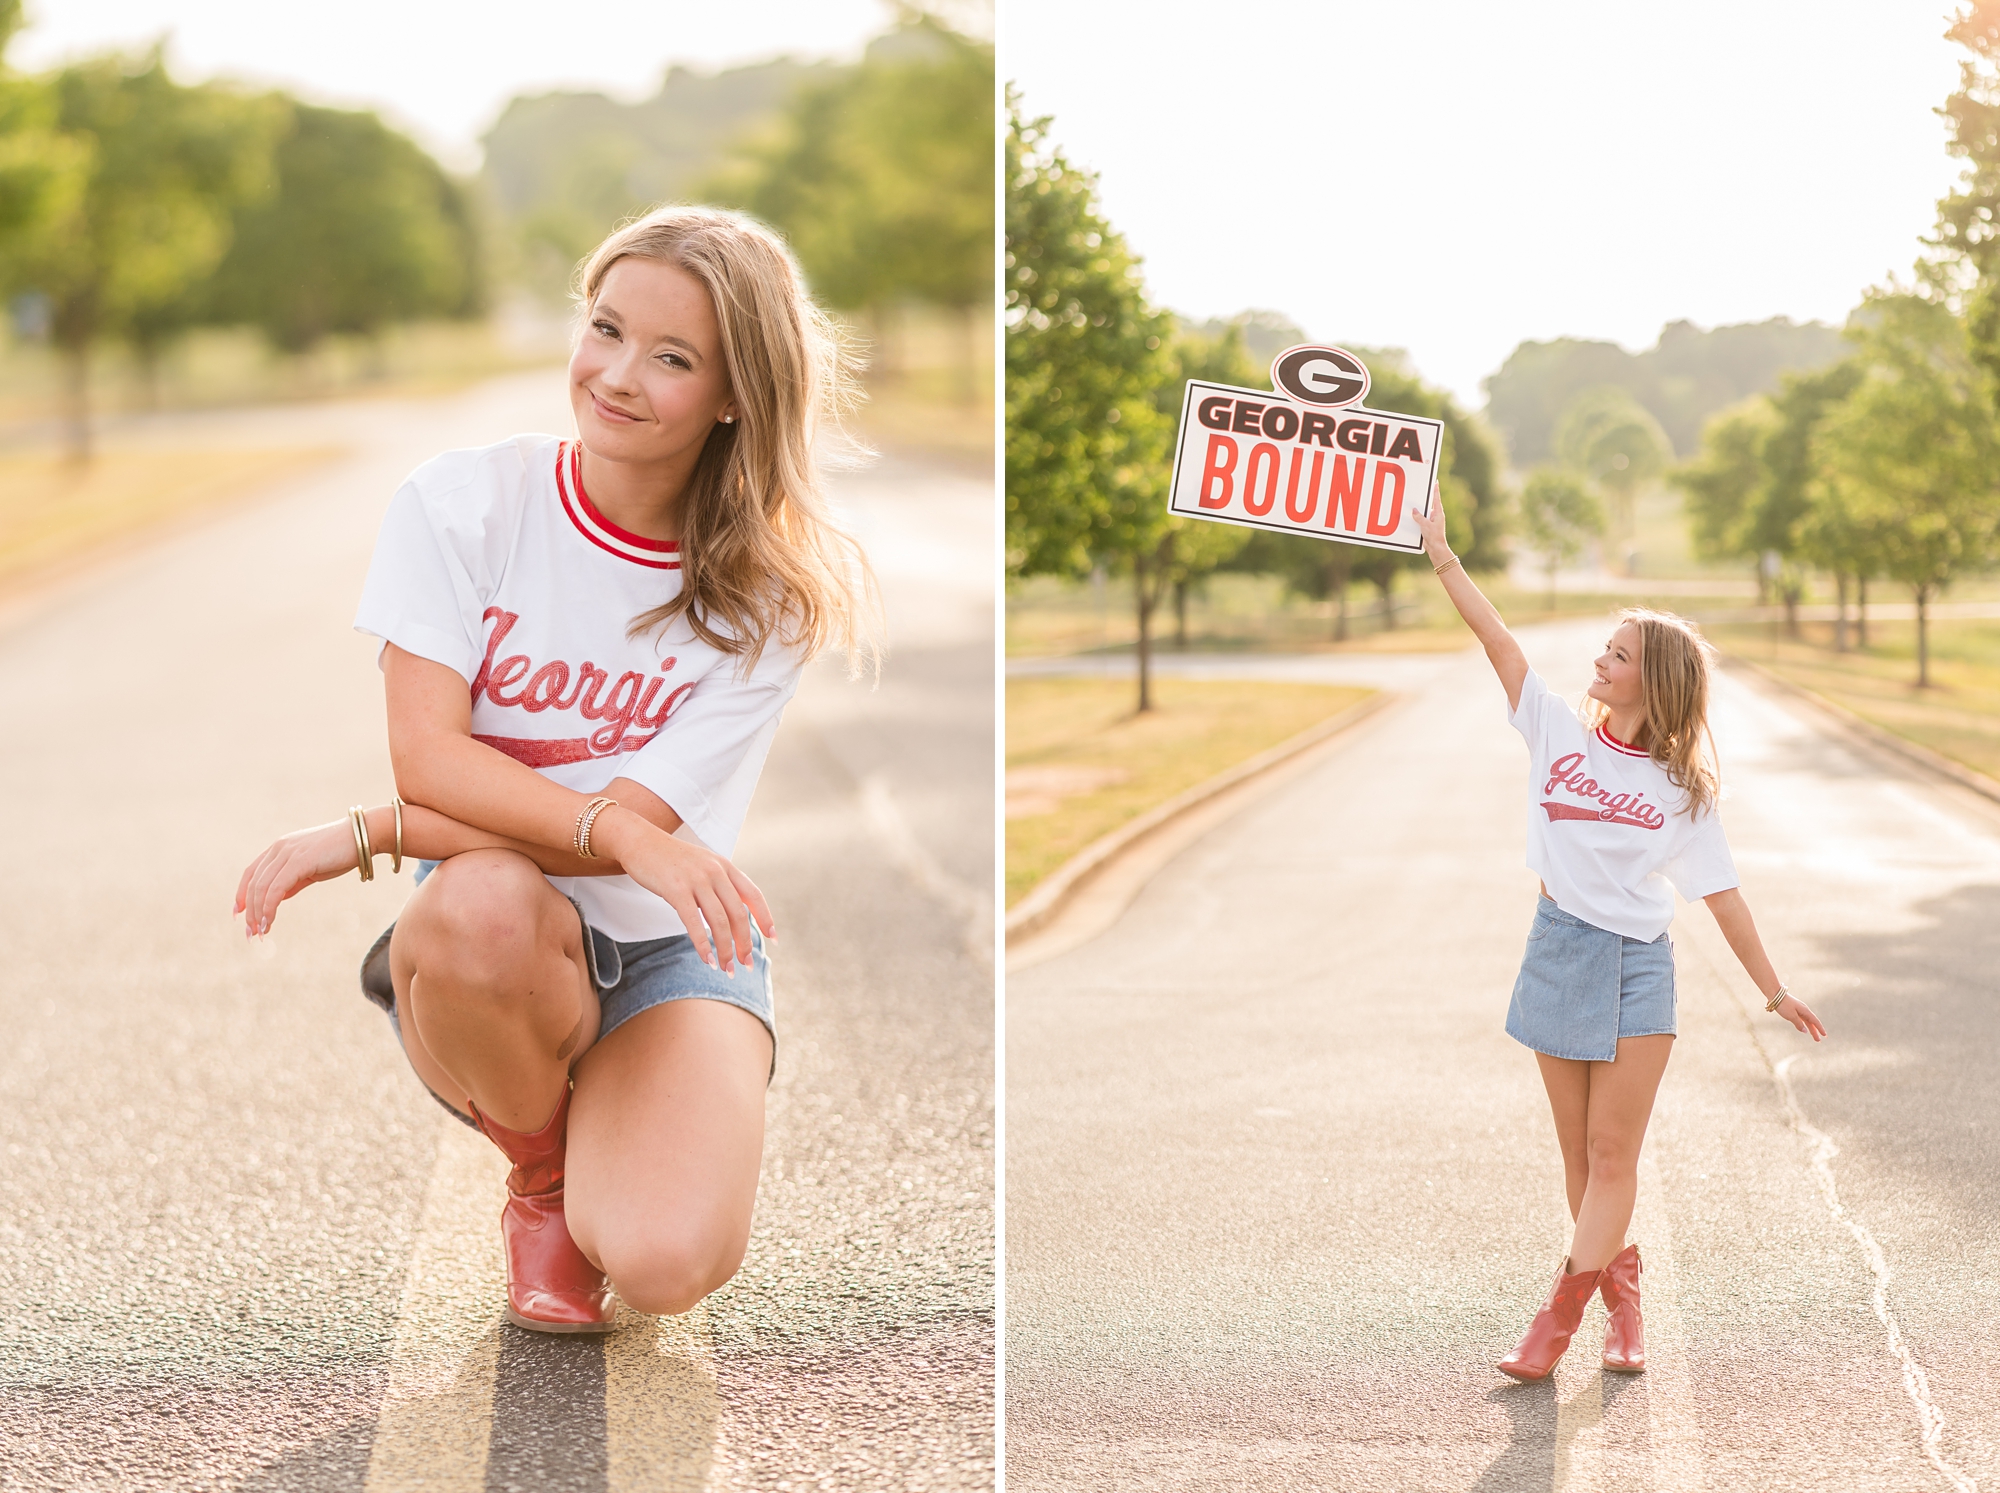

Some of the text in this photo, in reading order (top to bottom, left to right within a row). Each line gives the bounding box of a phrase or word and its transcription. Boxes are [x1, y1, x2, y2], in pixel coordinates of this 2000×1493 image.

[1278, 350, 1364, 404] G
[1198, 396, 1424, 463] GEORGIA
[1198, 433, 1406, 537] BOUND
[1545, 752, 1663, 824] Georgia
